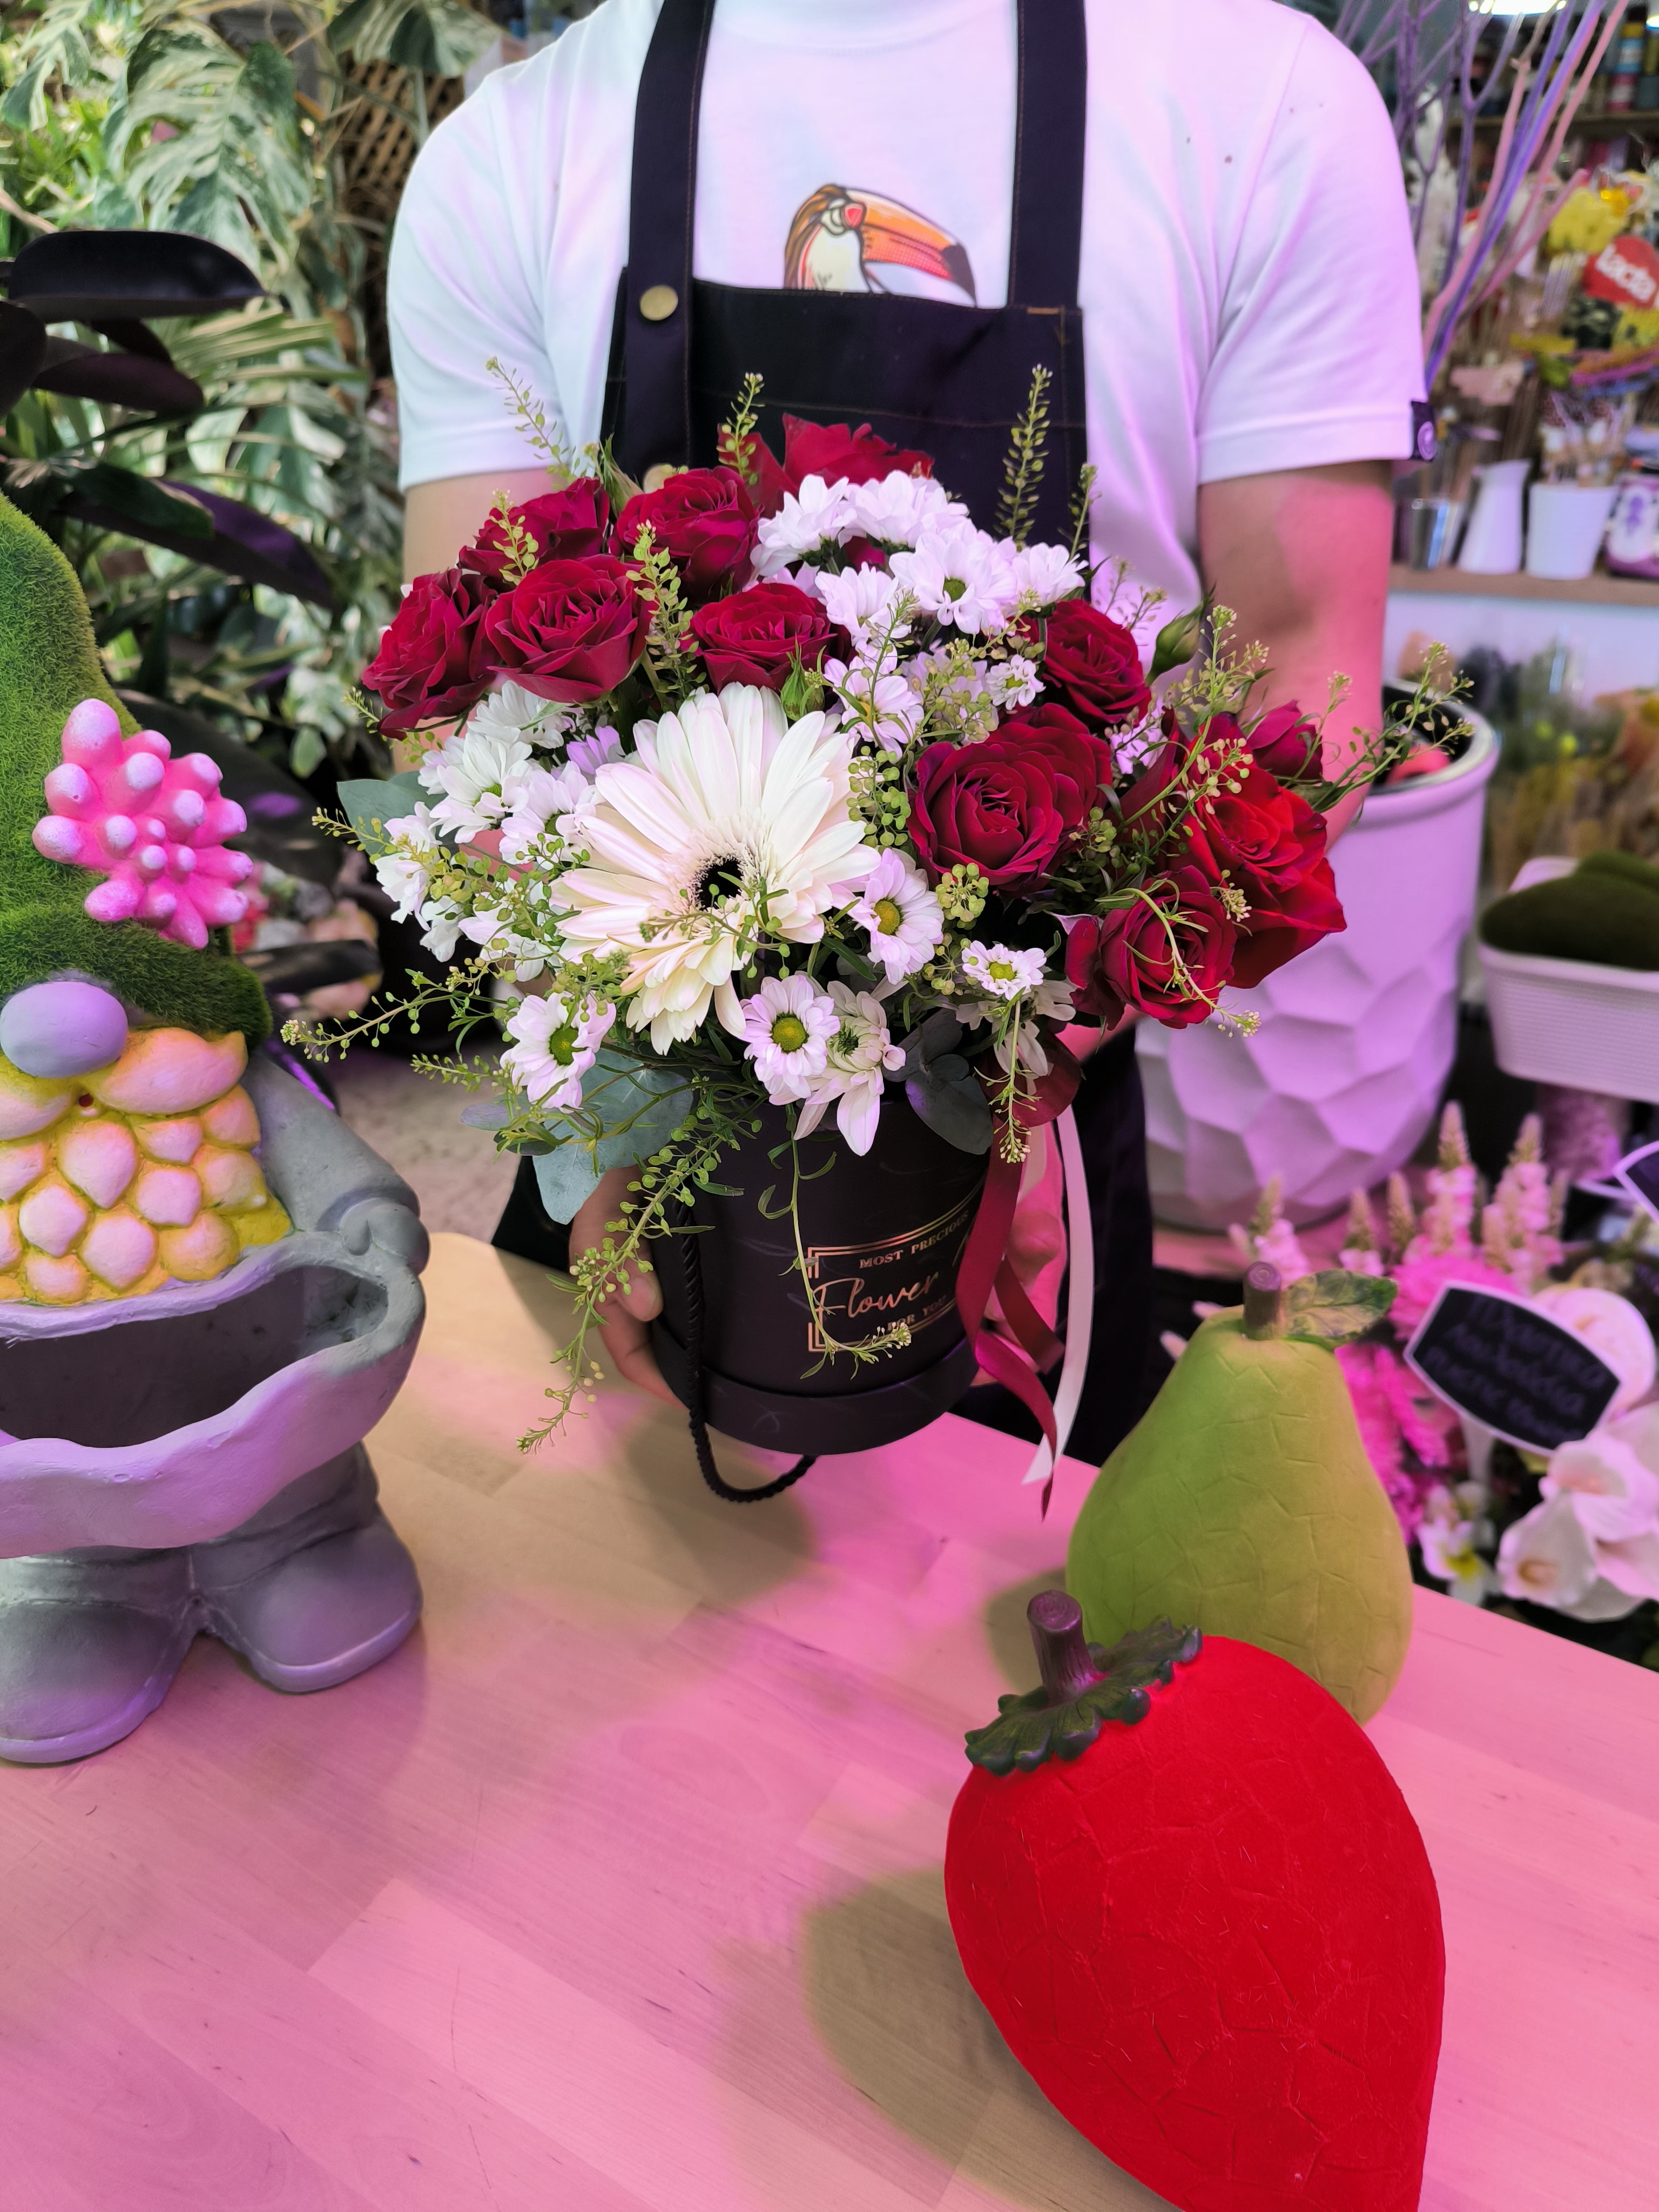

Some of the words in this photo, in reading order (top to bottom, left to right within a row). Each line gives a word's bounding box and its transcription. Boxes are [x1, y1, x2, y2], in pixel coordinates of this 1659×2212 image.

[859, 1250, 903, 1269] MOST
[911, 1210, 968, 1255] PRECIOUS
[813, 1272, 939, 1328] Flower
